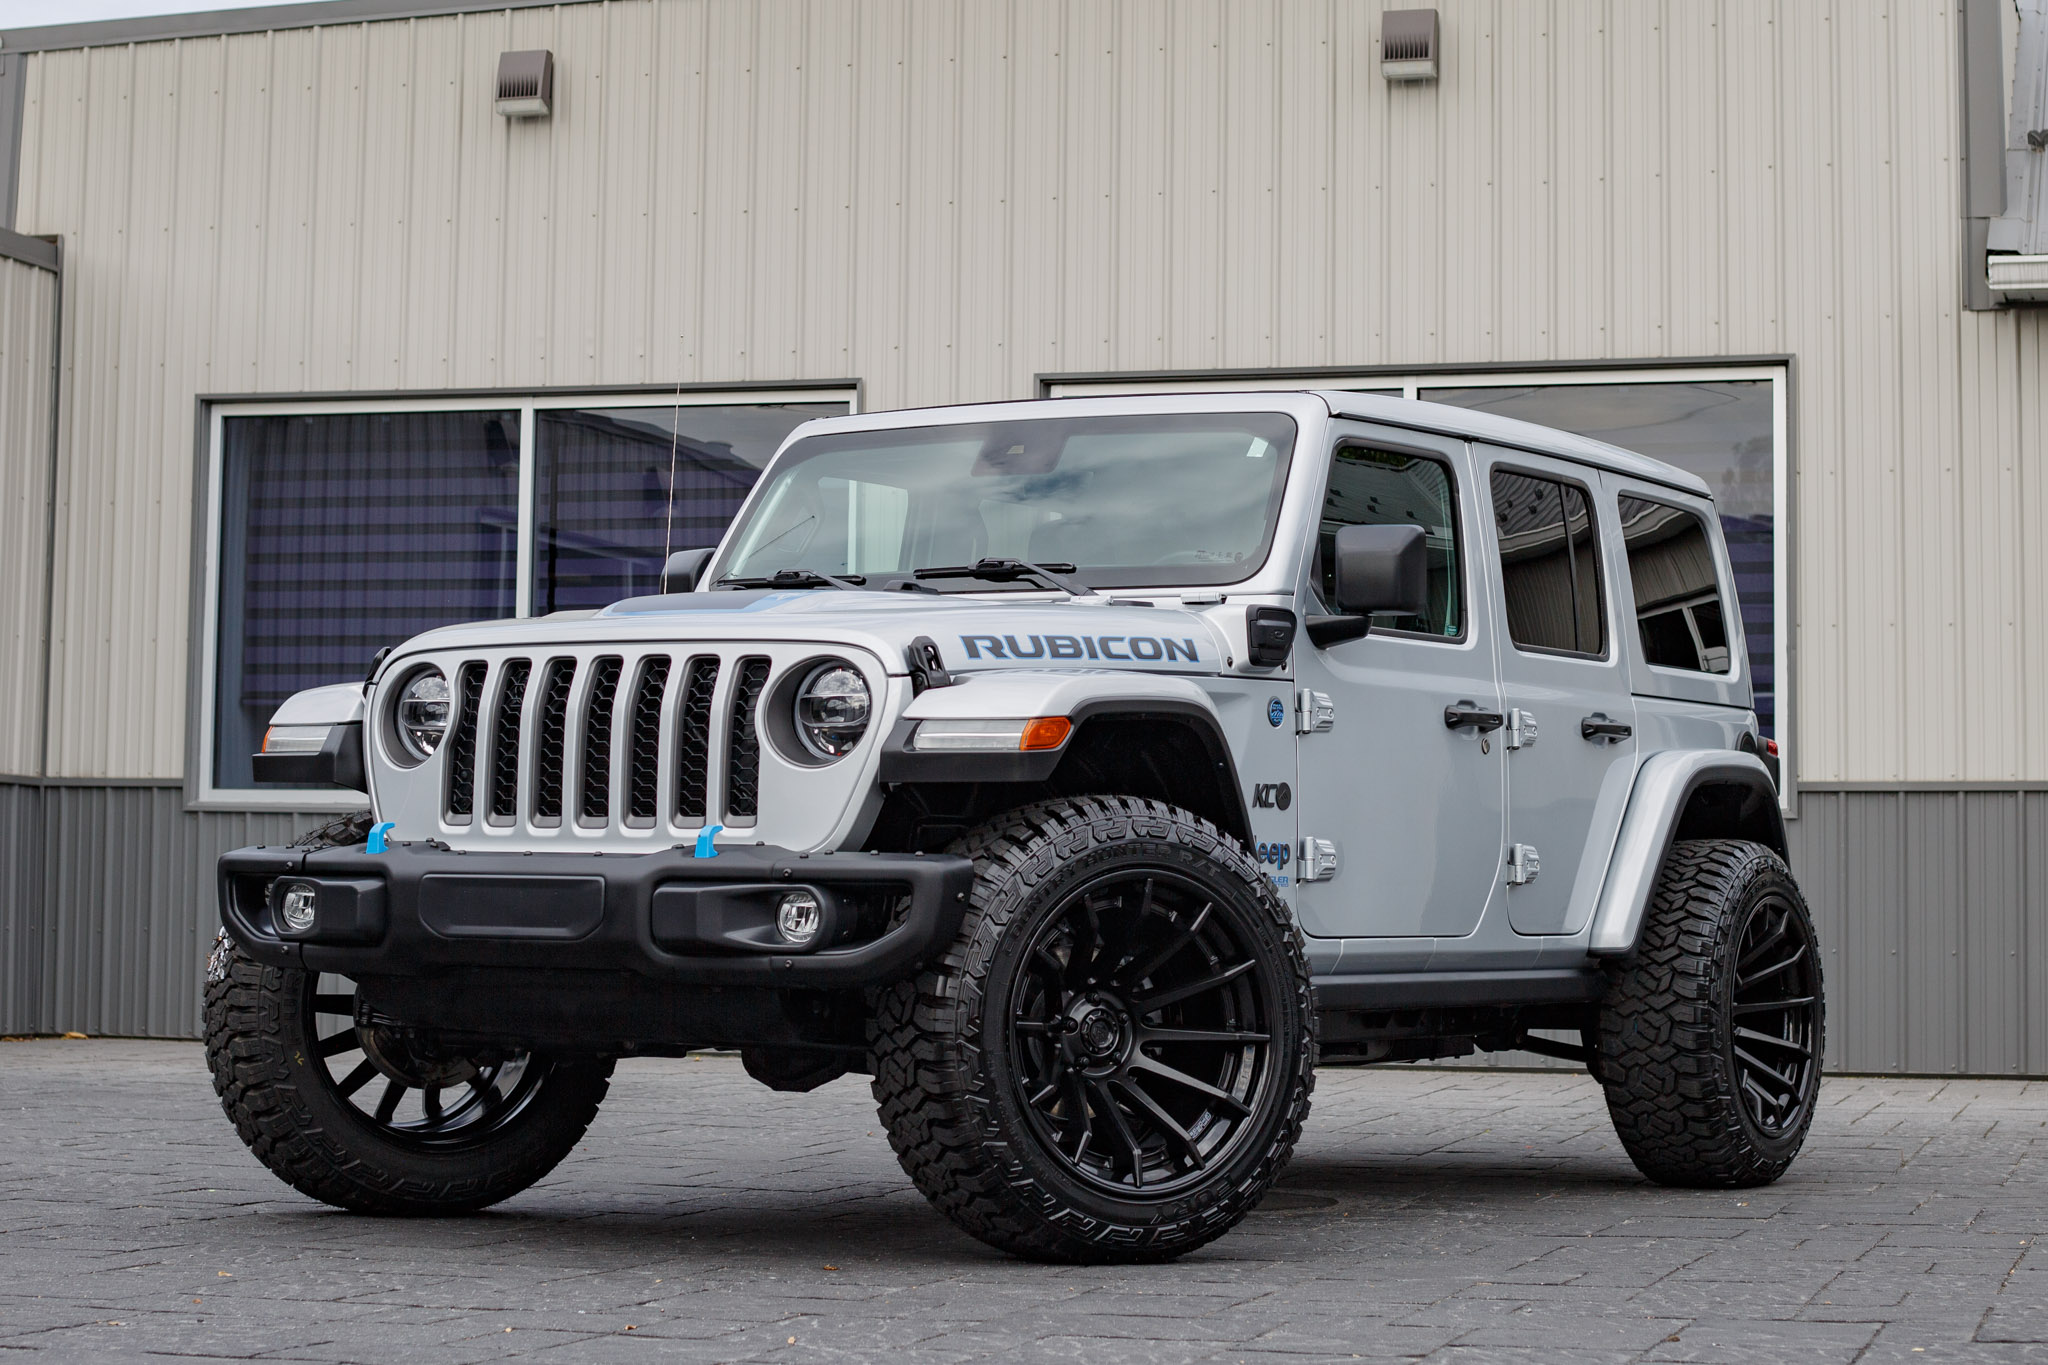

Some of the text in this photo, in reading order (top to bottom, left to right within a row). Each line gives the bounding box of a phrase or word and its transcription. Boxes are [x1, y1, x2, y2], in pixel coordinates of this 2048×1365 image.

[958, 634, 1201, 663] RUBICON
[1083, 843, 1172, 869] HUNTER
[1178, 850, 1221, 877] R/T
[1255, 840, 1291, 870] eep
